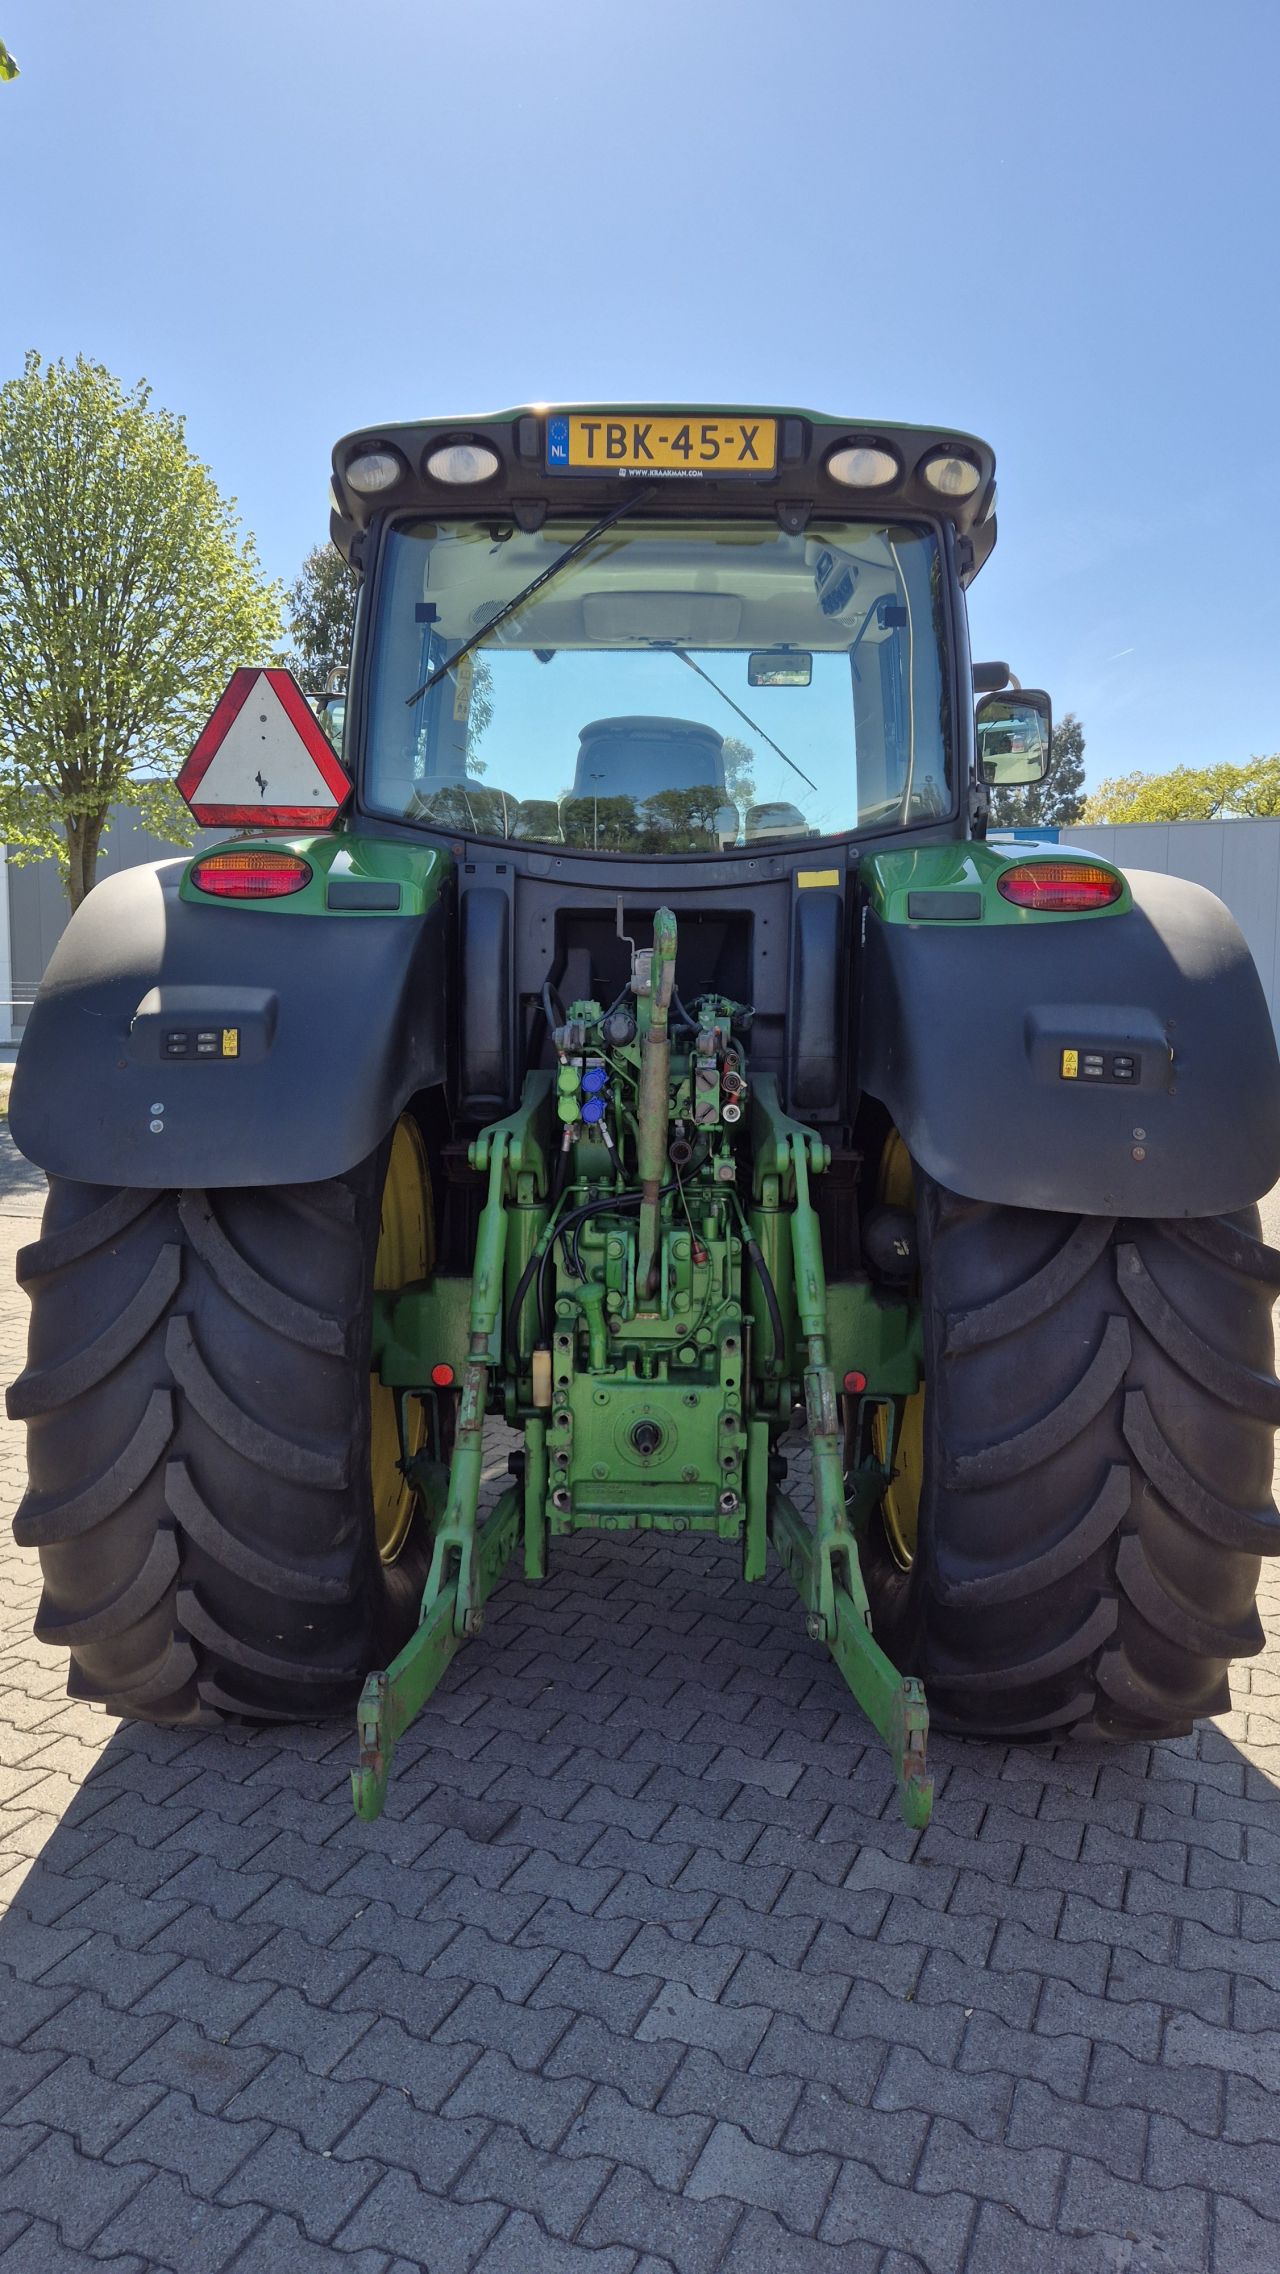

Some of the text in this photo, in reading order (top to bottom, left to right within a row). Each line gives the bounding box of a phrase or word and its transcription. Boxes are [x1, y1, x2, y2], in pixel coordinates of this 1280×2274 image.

[580, 423, 759, 461] TBK-45-X
[552, 445, 566, 457] NL
[628, 469, 703, 477] WWW.KRAAKMAN.COM
